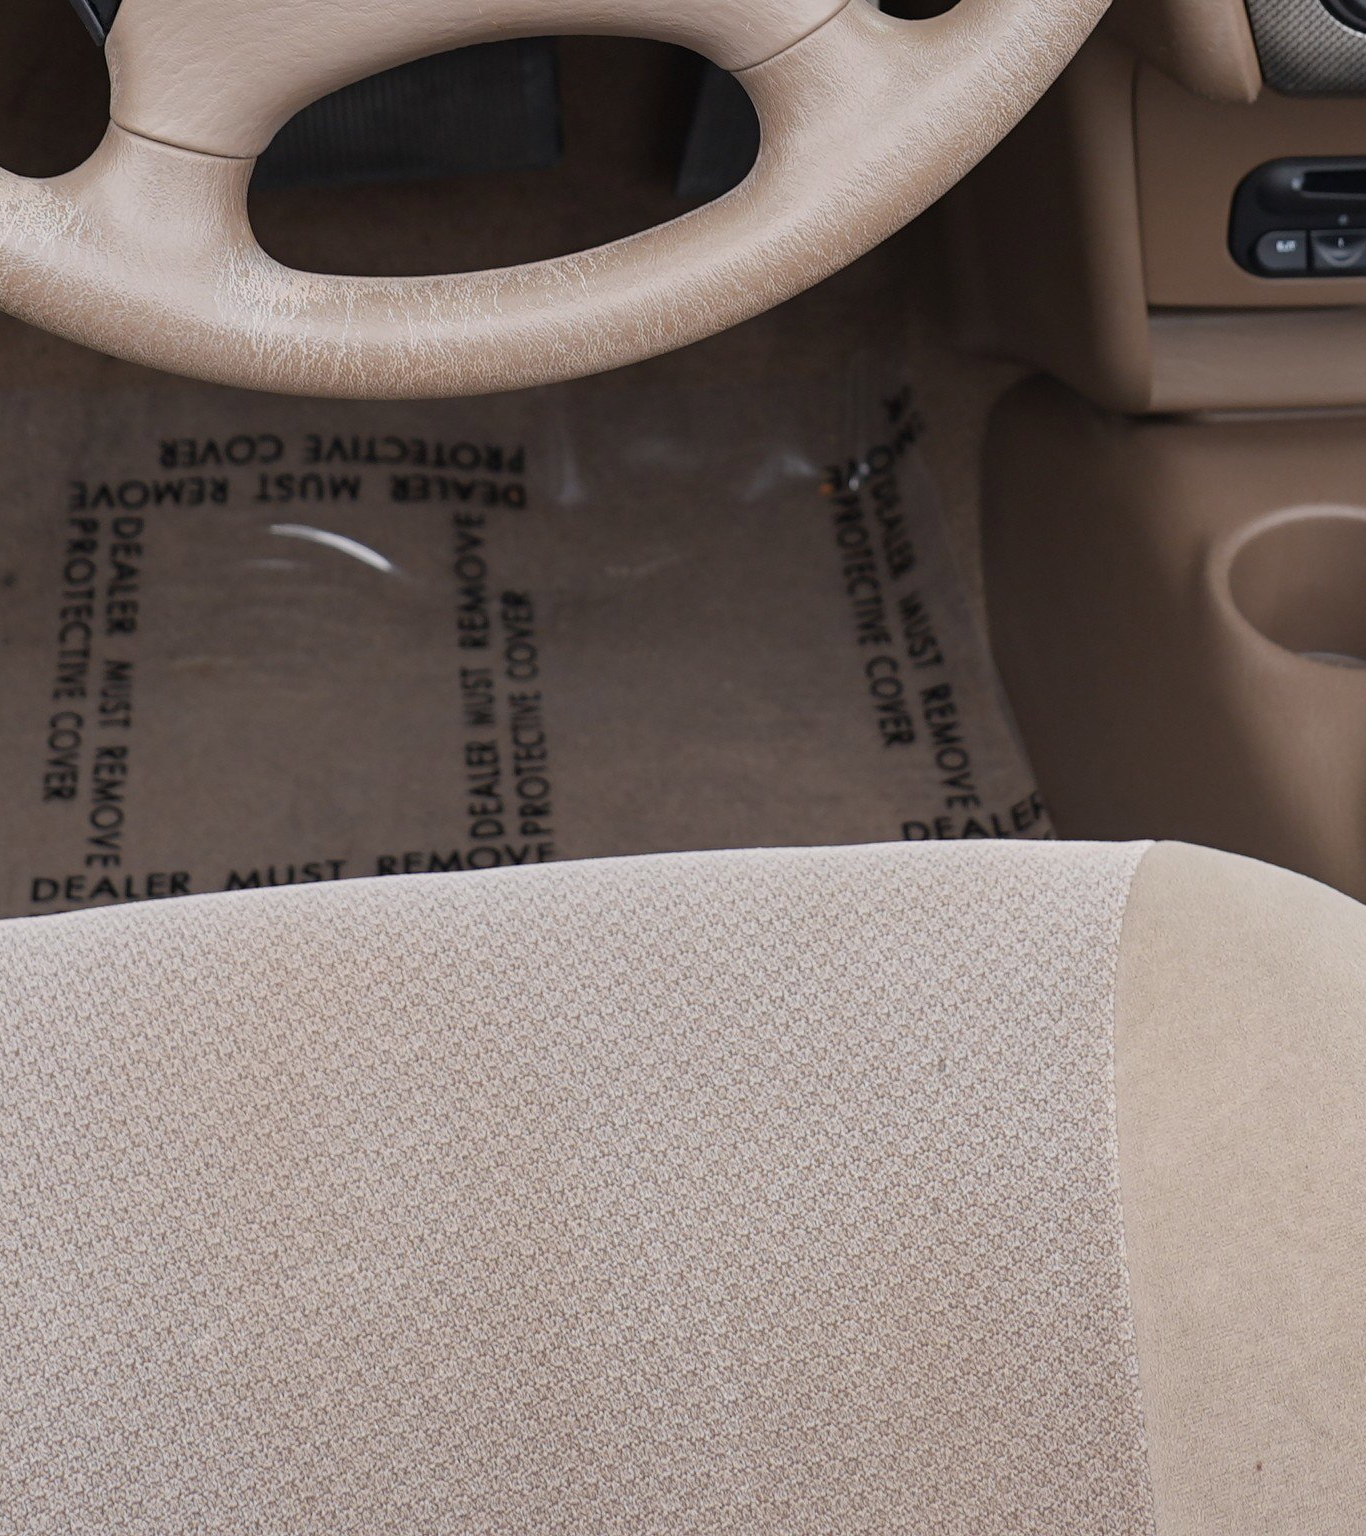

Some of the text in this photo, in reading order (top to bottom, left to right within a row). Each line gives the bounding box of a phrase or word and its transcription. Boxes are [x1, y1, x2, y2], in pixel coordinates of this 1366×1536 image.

[68, 472, 527, 511] DEALER MUST REMOVE
[159, 433, 526, 474] PROTECTIVE COVER
[42, 517, 100, 803] PROTECTIVE COVER
[454, 514, 505, 841] DEALER MUST REMOVE
[898, 590, 944, 669] MUST
[84, 516, 145, 868] DEALER MUST REMOVE
[502, 590, 554, 837] PROTECTIVE COVER
[865, 656, 916, 748] COVER
[920, 682, 981, 811] REMOVE
[31, 842, 557, 903] DEALER MUST REMOVE
